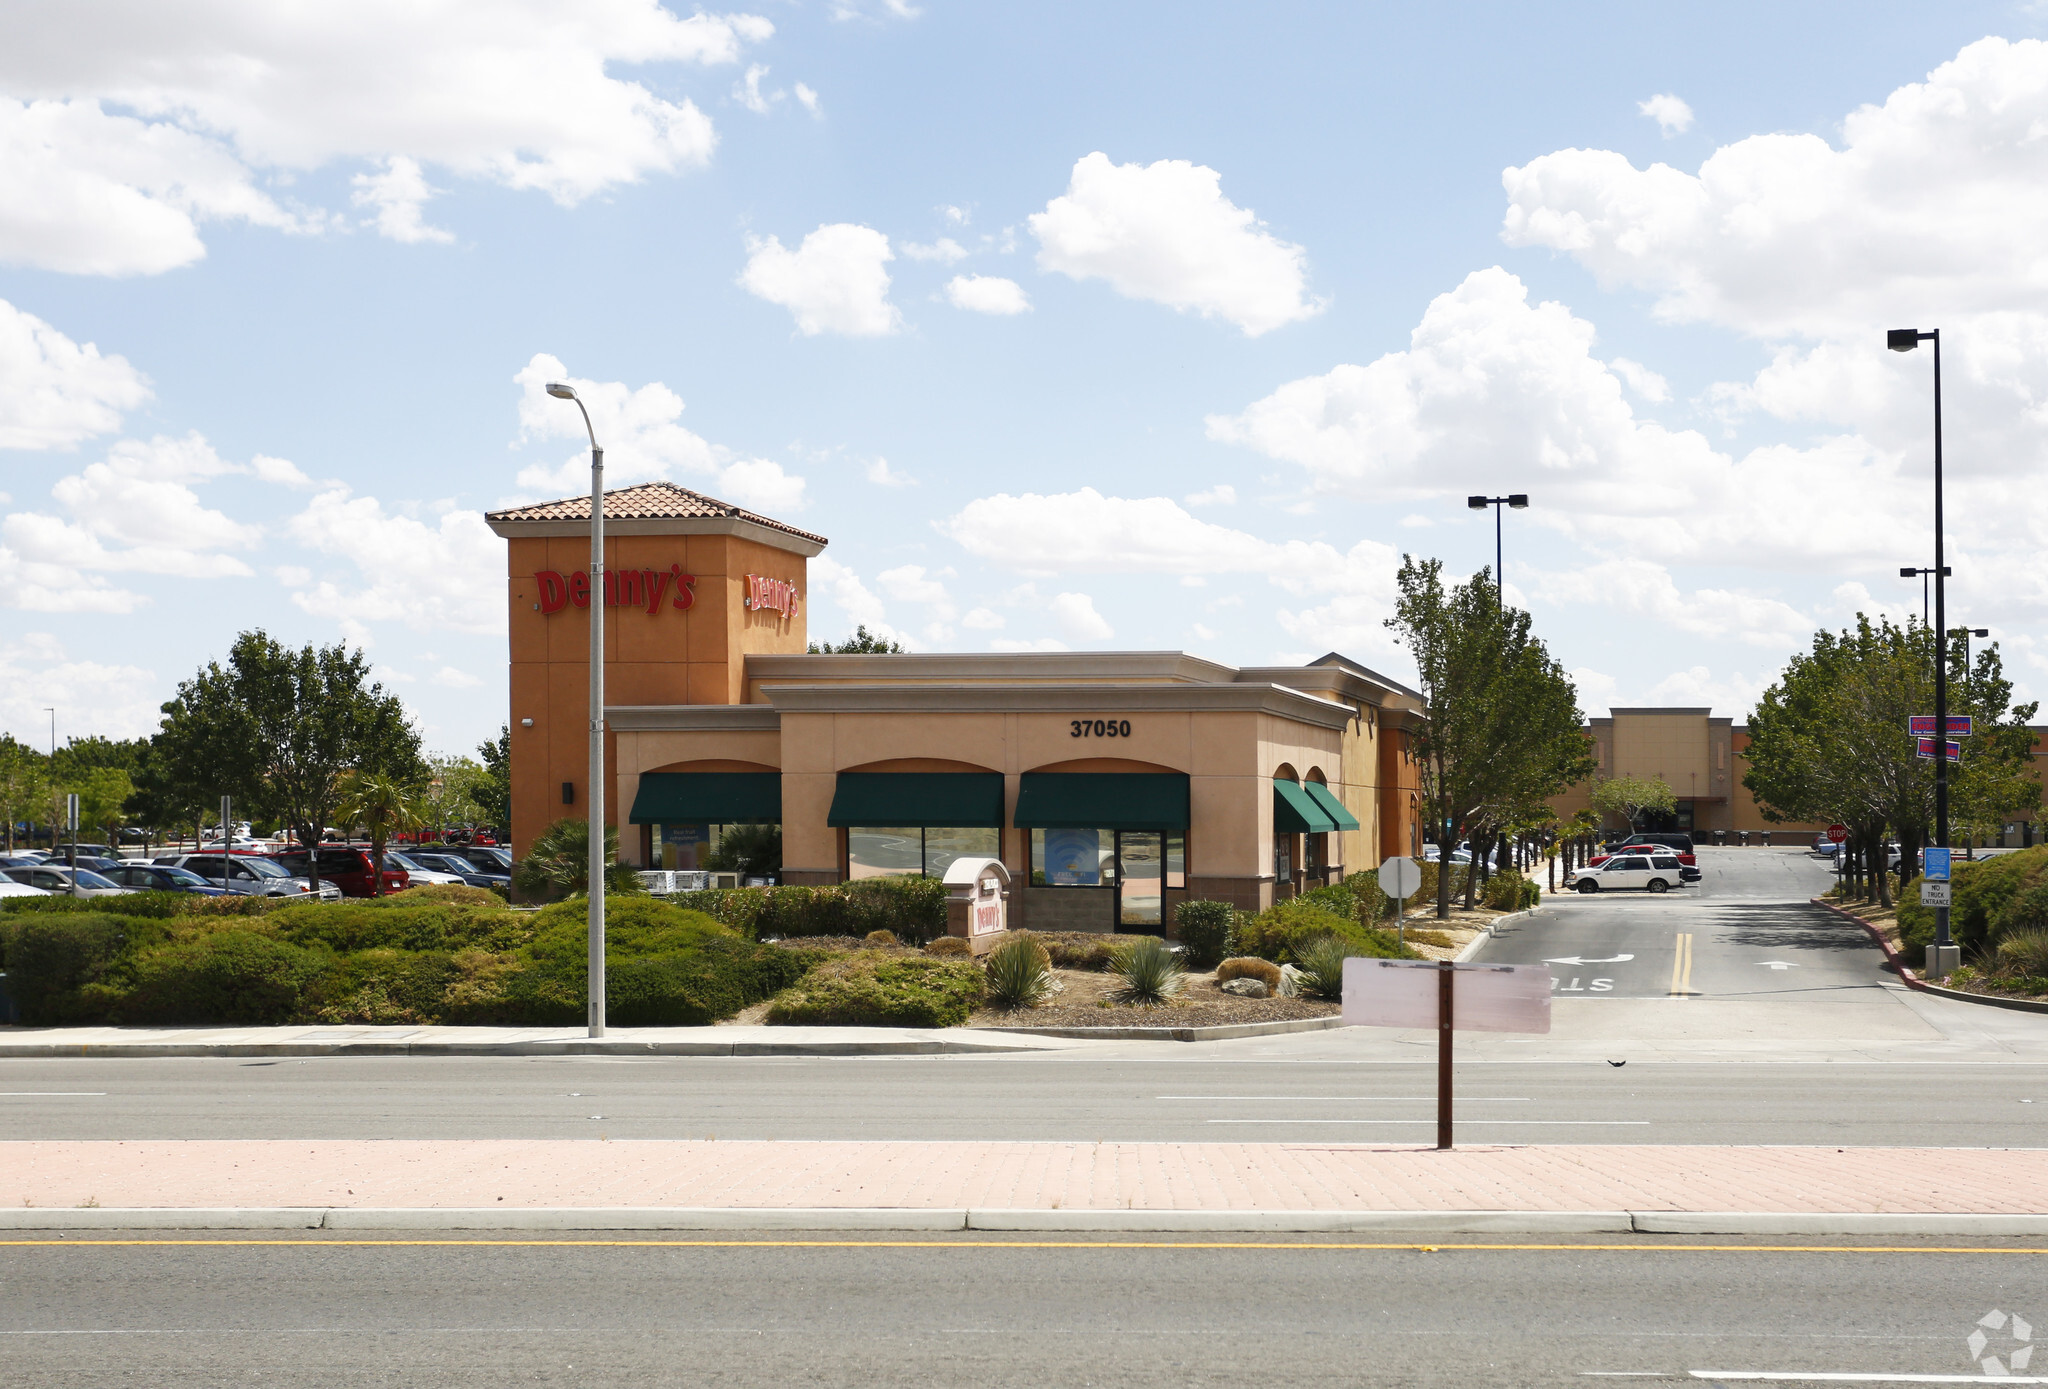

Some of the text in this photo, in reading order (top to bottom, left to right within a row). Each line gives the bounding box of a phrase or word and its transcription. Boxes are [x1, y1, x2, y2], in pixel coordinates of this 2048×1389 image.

[534, 563, 697, 615] Denny's
[745, 574, 799, 619] Denny's
[1070, 720, 1131, 737] 37050
[1911, 722, 1970, 731] ENGLNDER
[1828, 829, 1846, 838] STOP
[977, 903, 1000, 932] Denny's
